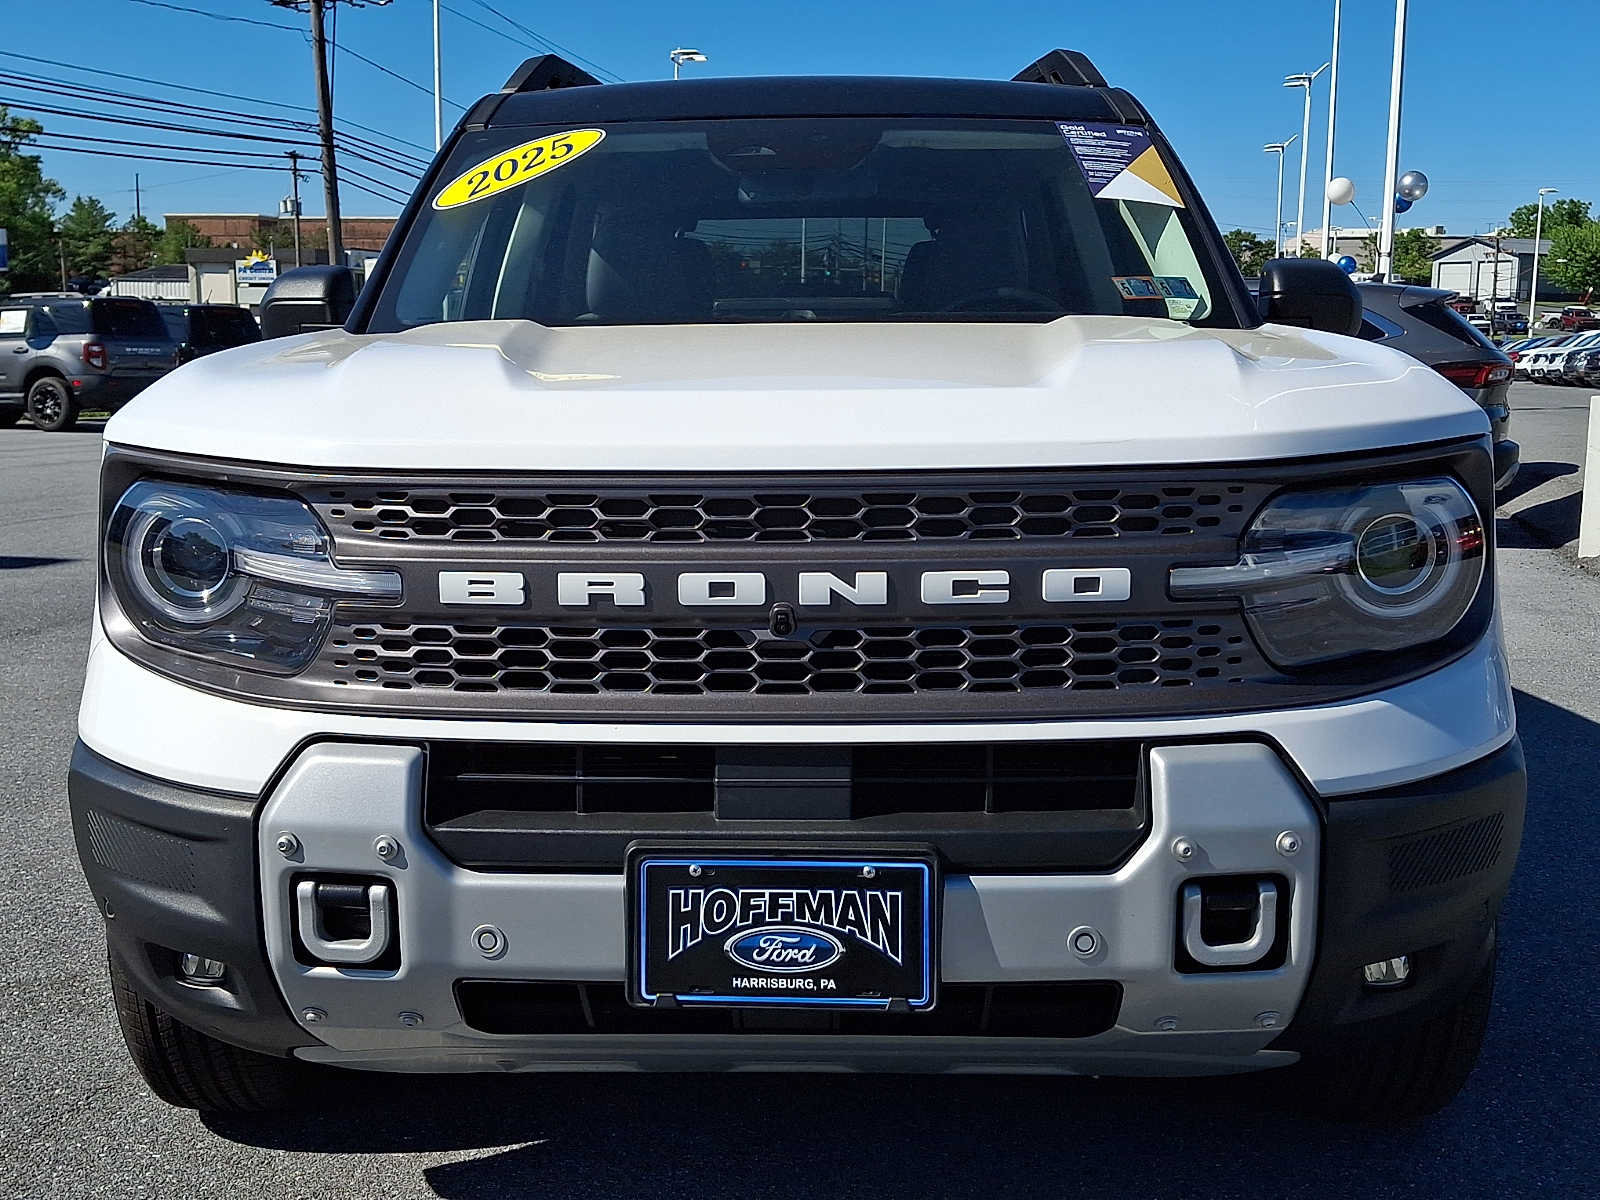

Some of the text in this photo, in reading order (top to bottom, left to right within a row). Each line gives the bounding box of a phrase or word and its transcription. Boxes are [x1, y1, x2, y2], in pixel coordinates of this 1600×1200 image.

[1059, 124, 1086, 132] Gold
[1062, 129, 1107, 138] Certified
[467, 135, 575, 198] 2025
[438, 567, 1132, 607] BRONCO
[667, 887, 904, 966] HOFFMAN
[752, 935, 817, 963] Ford
[732, 978, 837, 991] HARRISBURG, PA
